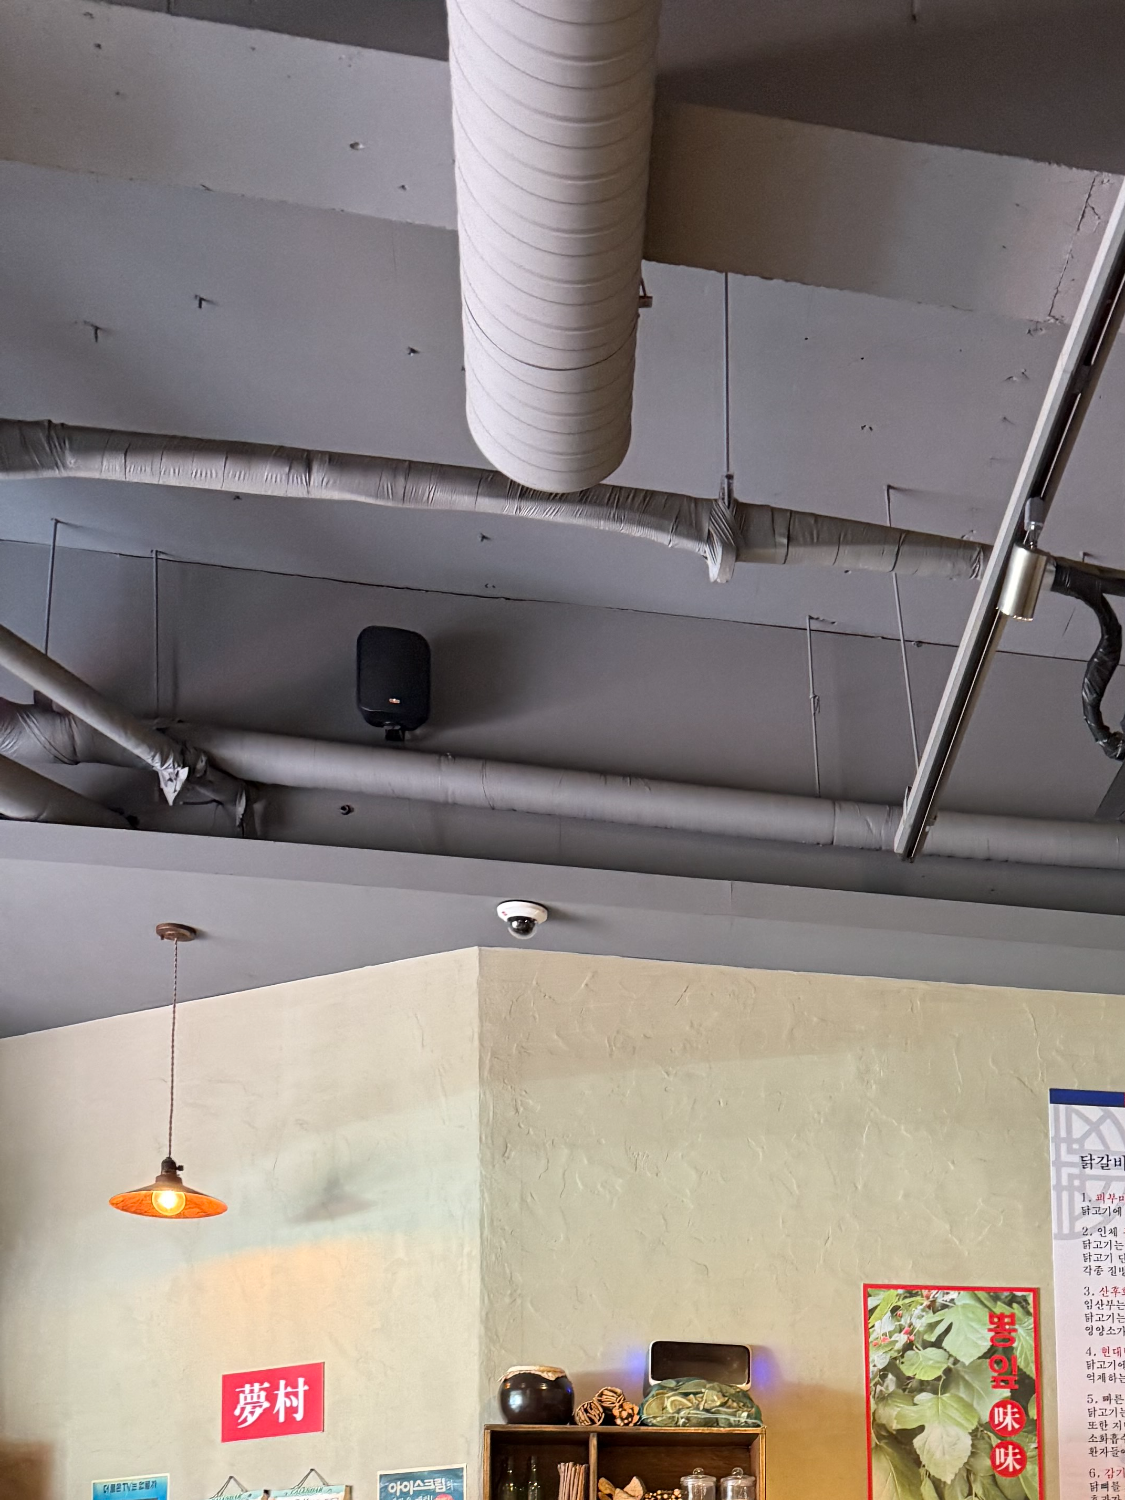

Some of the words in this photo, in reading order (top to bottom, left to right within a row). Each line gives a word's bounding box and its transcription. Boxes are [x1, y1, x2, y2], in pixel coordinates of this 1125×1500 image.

[1081, 1226, 1093, 1236] 2.
[1096, 1225, 1118, 1238] 인체
[1082, 1264, 1104, 1276] 각종
[1083, 1286, 1095, 1296] 3.
[1083, 1298, 1125, 1311] 임산부는
[1085, 1346, 1096, 1356] 4.
[233, 1377, 309, 1428] 夢村
[1086, 1393, 1098, 1404] 5.
[1101, 1393, 1124, 1405] 빠른
[1087, 1419, 1108, 1431] 또한
[1088, 1467, 1100, 1479] 6.
